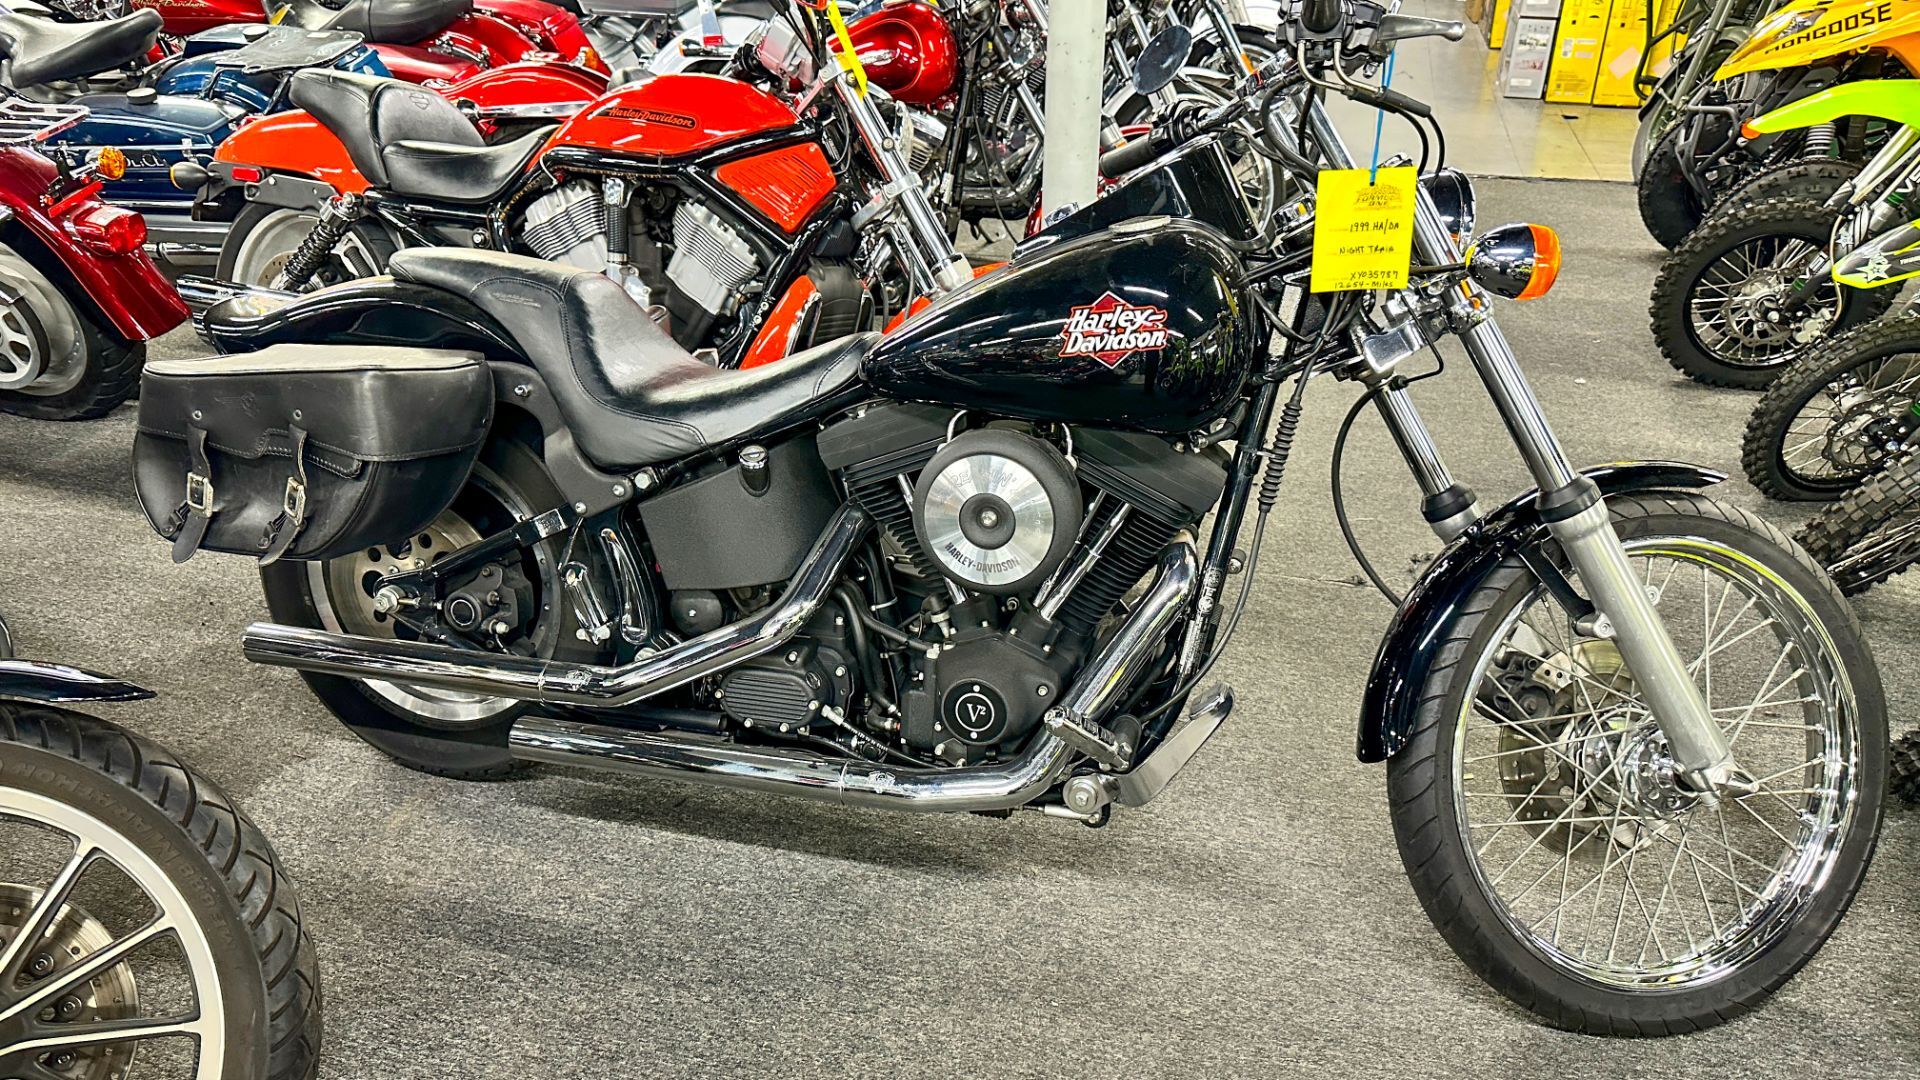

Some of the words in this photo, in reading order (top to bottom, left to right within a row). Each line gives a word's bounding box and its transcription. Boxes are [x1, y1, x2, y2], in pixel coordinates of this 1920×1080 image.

[1350, 222, 1369, 232] 1999
[1065, 329, 1166, 354] Davidson
[944, 542, 1020, 574] HARLEY-DAVIDSON
